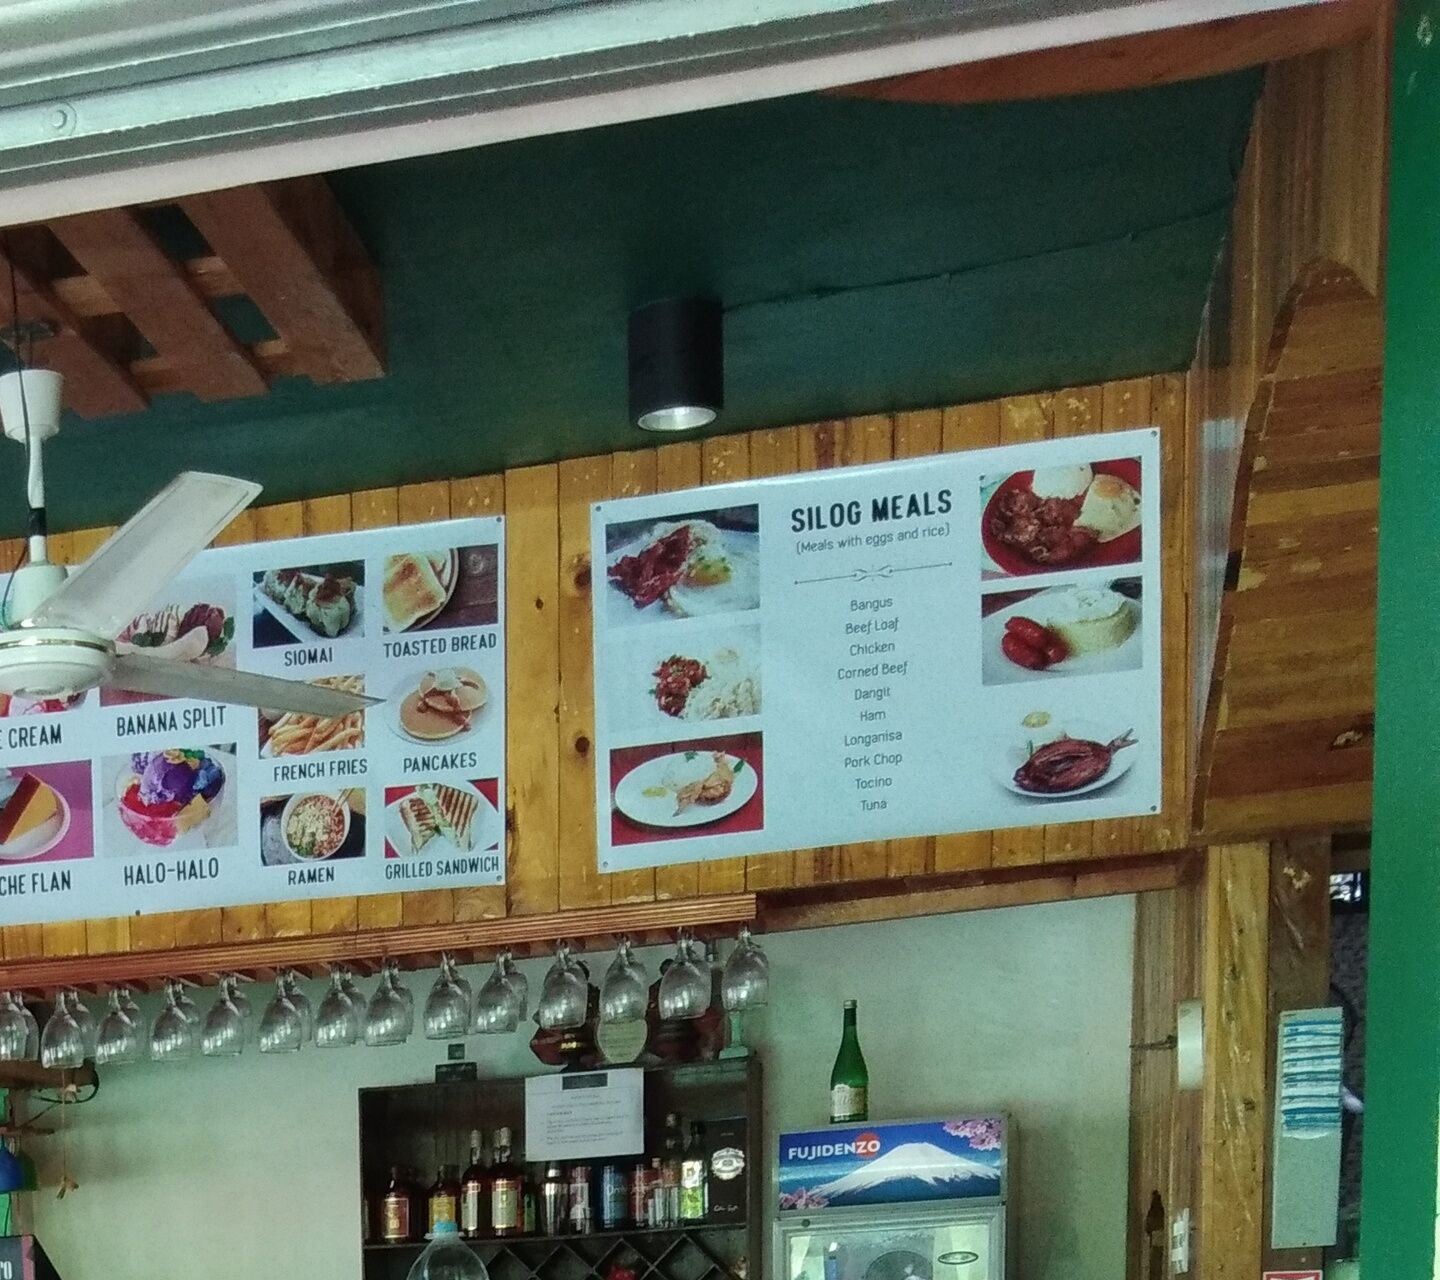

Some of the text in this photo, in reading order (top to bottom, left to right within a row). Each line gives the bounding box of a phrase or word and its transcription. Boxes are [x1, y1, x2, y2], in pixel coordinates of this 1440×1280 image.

[791, 489, 952, 533] SILOG MEALS
[796, 522, 950, 555] (Meals with eggs and rice)
[850, 598, 893, 612] Bangus
[846, 617, 899, 635] Beef Loaf
[284, 646, 333, 666] SIOMAI
[383, 633, 497, 659] TOASTED BREAD
[850, 642, 895, 656] Chicken
[838, 661, 908, 680] Corned Beef
[854, 687, 890, 701] Dangit
[116, 706, 226, 737] BANANA SPLIT
[860, 710, 886, 722] Ham
[8, 723, 62, 748] CREAM
[844, 730, 902, 747] Longanisa
[274, 758, 368, 782] FRENCH FRIES
[402, 752, 478, 773] PANCAKES
[844, 752, 902, 768] Pork Chop
[855, 776, 892, 790] Tocino
[860, 800, 888, 812] Tuna
[123, 857, 220, 886] HALO-HALO
[288, 866, 334, 886] RAMEN
[384, 856, 499, 880] GRILLED SANDWICH
[31, 870, 72, 894] FLAN
[788, 1140, 881, 1161] FUJIDENZO
